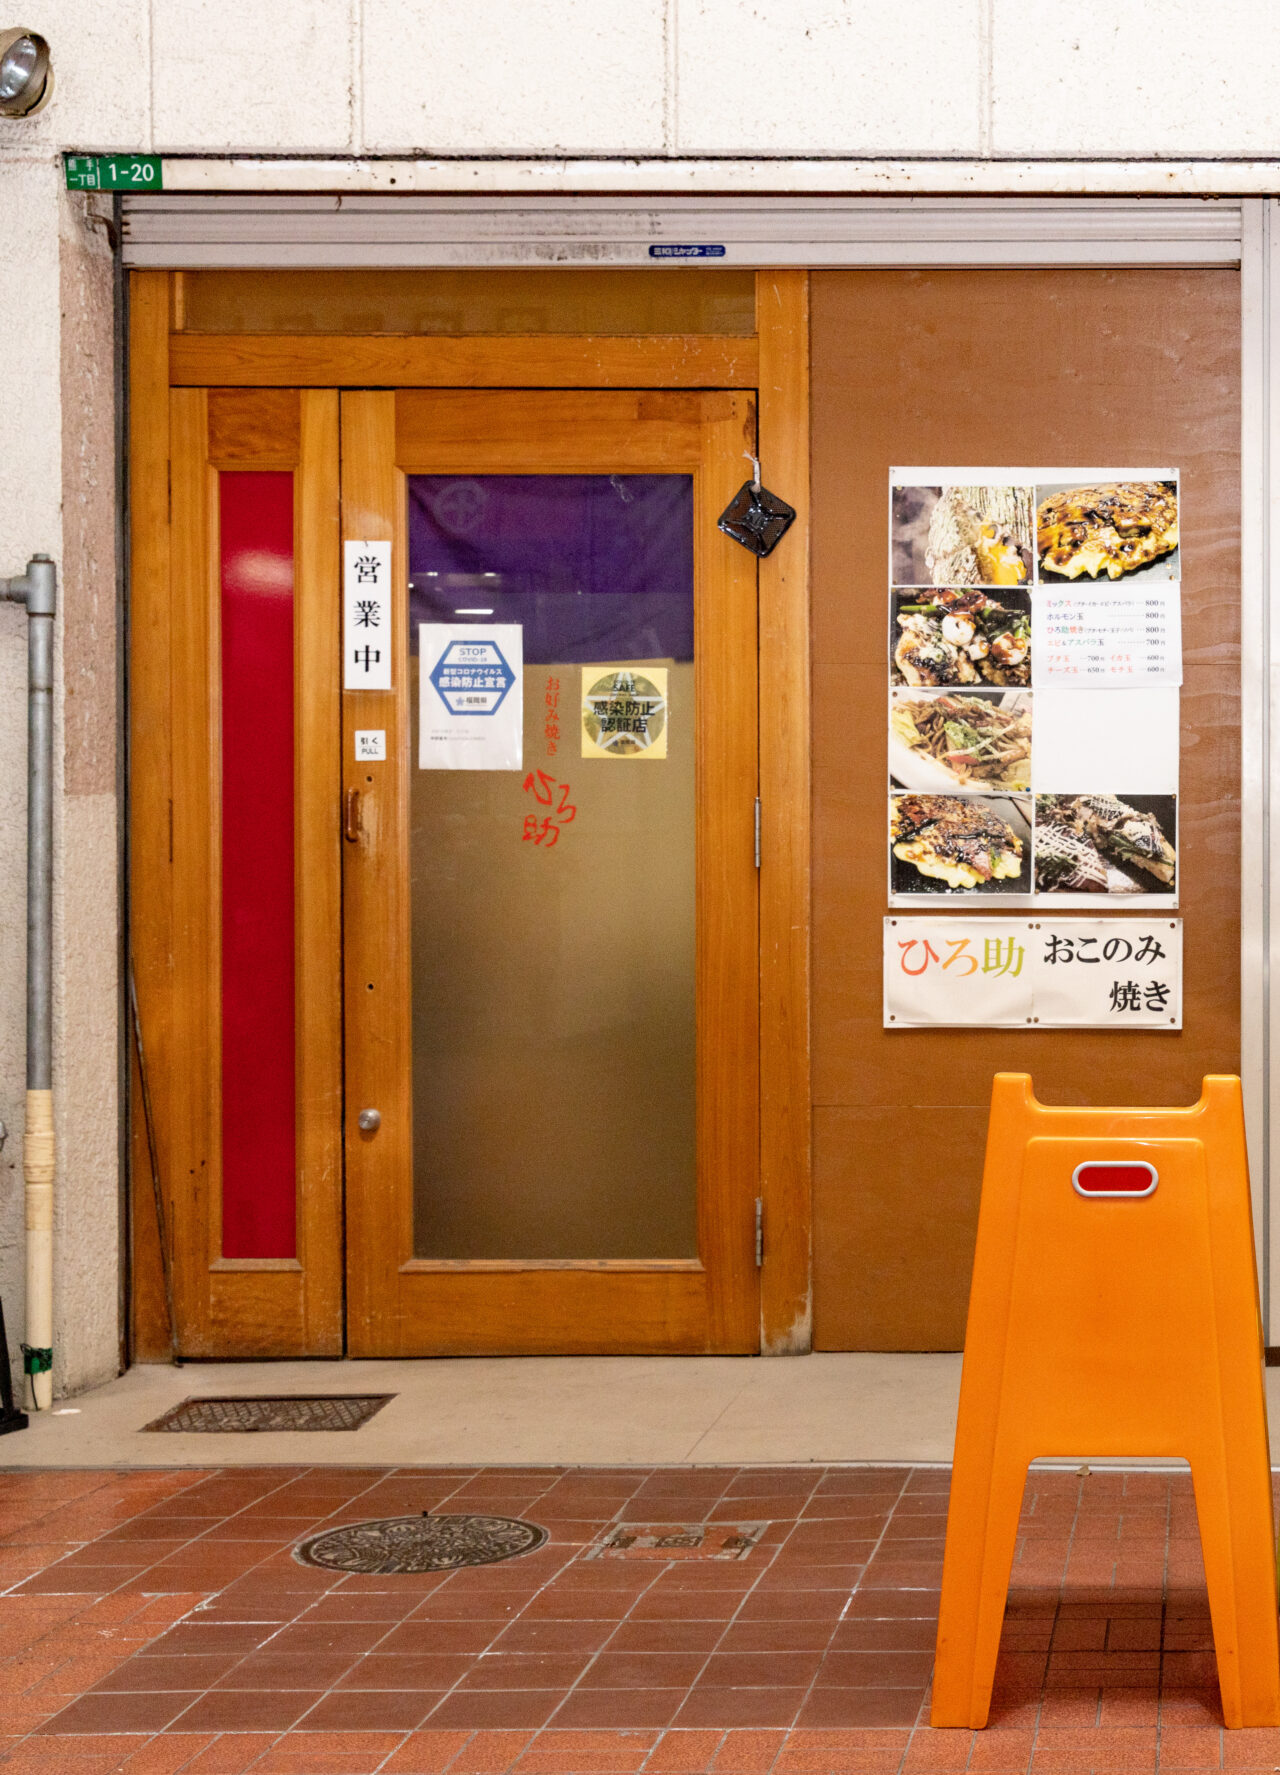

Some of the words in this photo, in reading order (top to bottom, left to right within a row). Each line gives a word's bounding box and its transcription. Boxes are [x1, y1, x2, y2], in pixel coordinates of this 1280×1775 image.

[109, 163, 154, 181] 1-20
[69, 174, 96, 186] 一丁目
[1046, 599, 1072, 607] ミックス
[353, 556, 382, 672] 営業中
[1047, 612, 1084, 620] ホルモン玉
[1046, 625, 1084, 634] ひろ助焼き
[459, 647, 487, 656] STOP
[438, 677, 507, 688] 感染防止宣言
[613, 684, 635, 692] SAFE
[594, 701, 655, 716] 感染防止
[545, 676, 560, 756] お好み焼き
[601, 718, 647, 733] 認証店
[361, 737, 379, 745] 引く
[361, 747, 379, 755] PULL
[898, 936, 1025, 978] ひろ助
[1044, 935, 1166, 965] おこのみ
[1109, 980, 1171, 1012] 焼き
